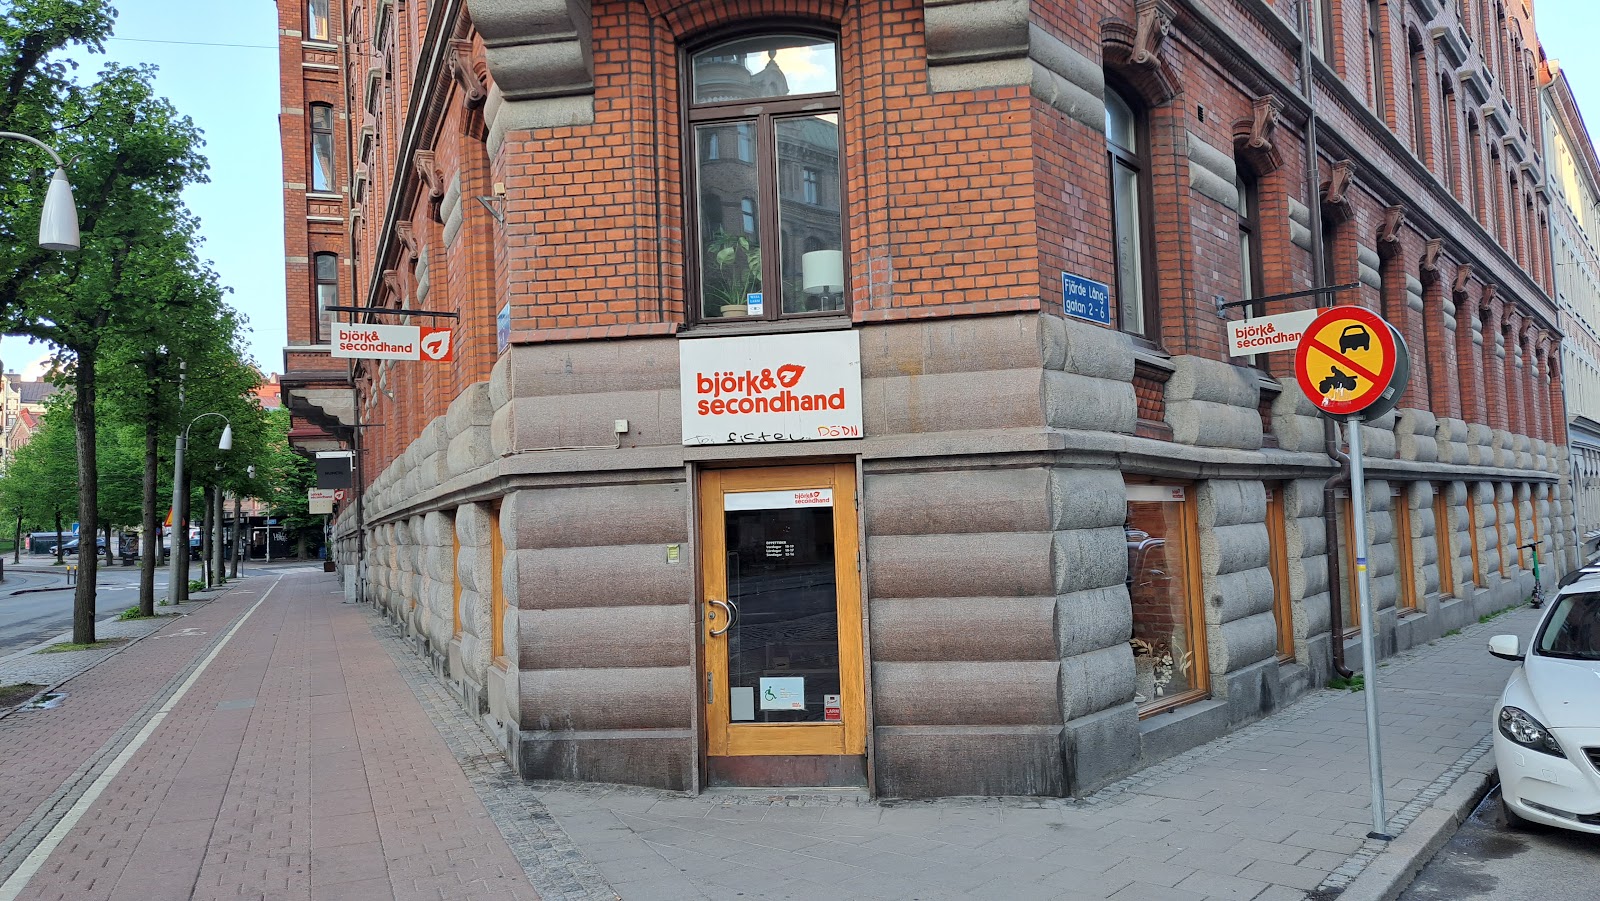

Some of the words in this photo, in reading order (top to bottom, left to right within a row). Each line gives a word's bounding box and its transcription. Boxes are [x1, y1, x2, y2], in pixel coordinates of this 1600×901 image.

[1064, 279, 1087, 297] Fjärde
[1066, 299, 1087, 314] gatan
[339, 330, 380, 343] björk&
[1235, 322, 1276, 339] björk&
[339, 342, 413, 353] secondhand
[1236, 332, 1302, 349] secondhan
[696, 368, 777, 397] björk&
[697, 388, 845, 416] secondhand
